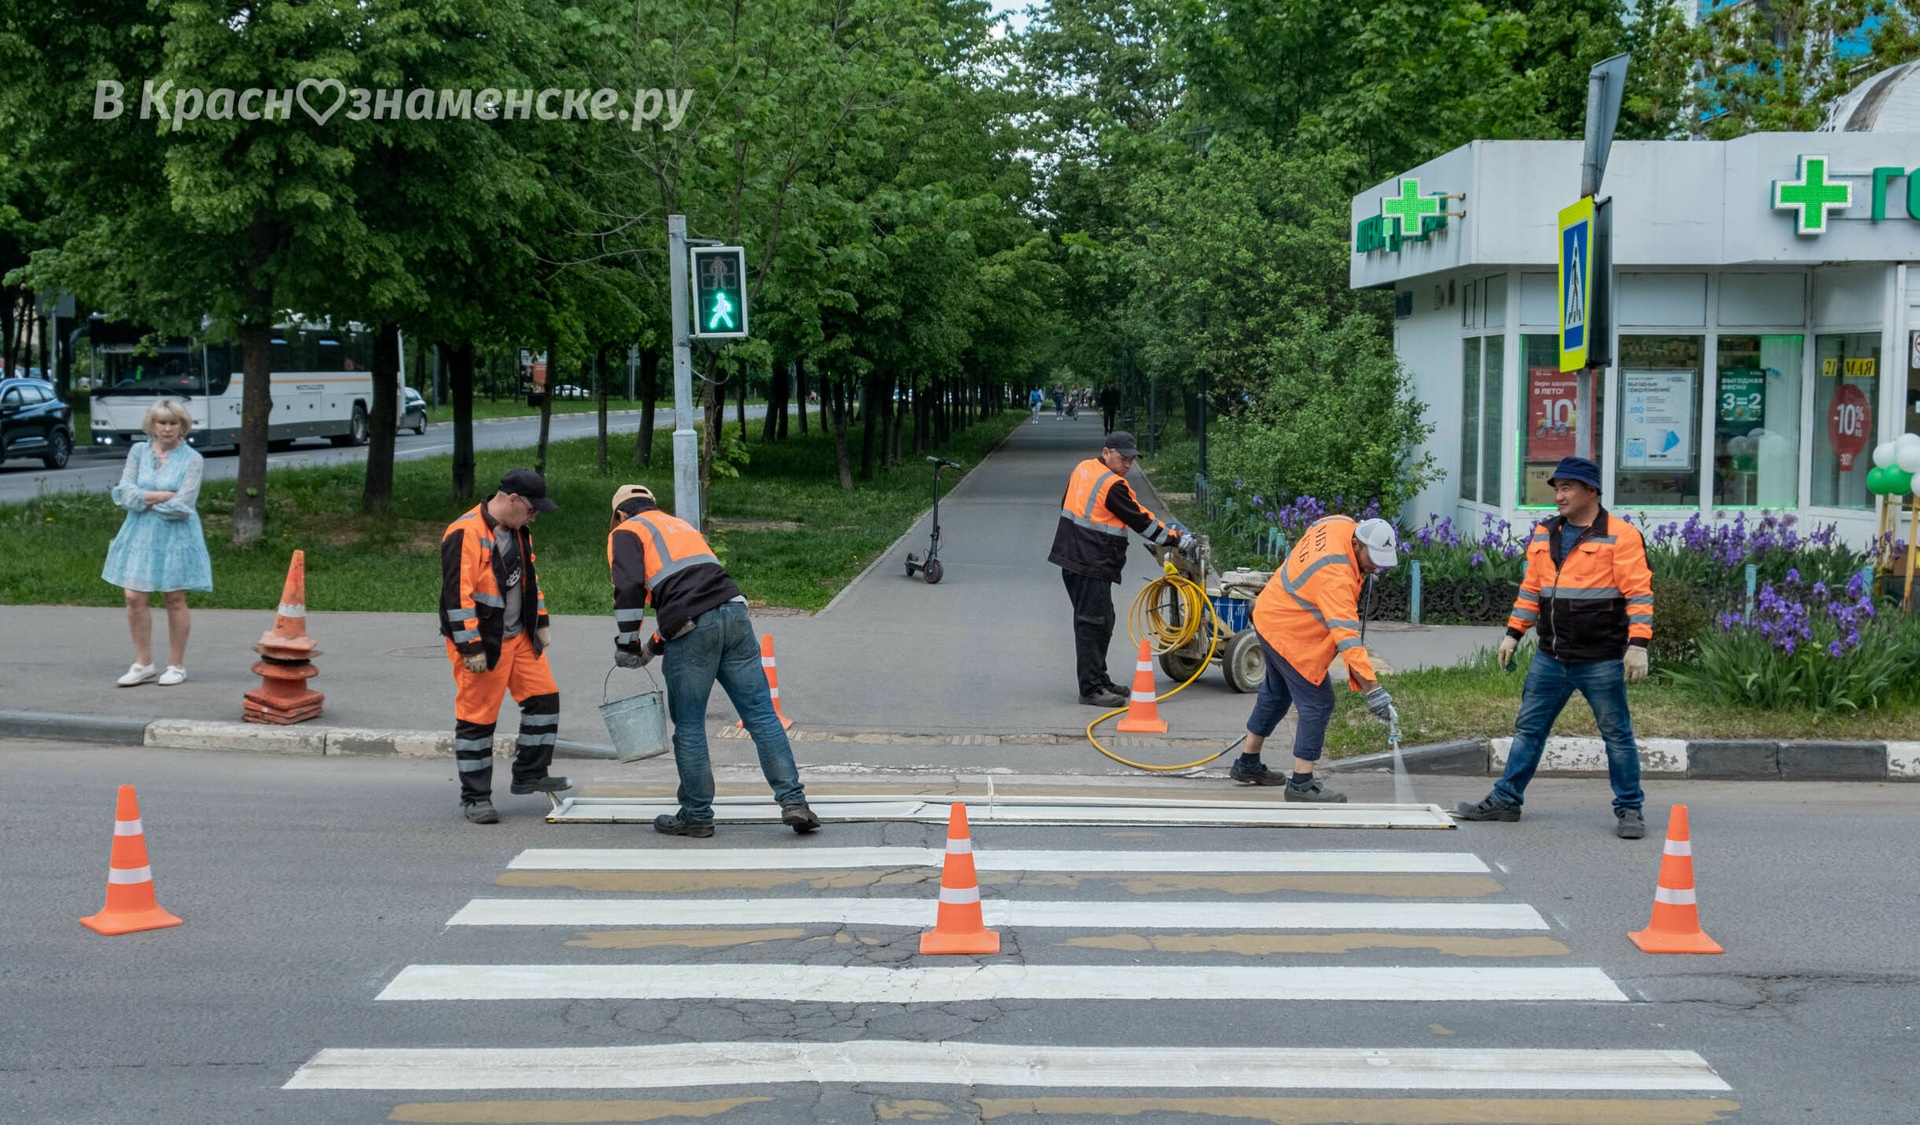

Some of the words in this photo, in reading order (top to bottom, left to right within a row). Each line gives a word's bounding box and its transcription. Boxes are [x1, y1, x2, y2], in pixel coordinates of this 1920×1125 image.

[1824, 360, 1837, 375] 21
[1845, 360, 1873, 376] МАЯ
[1535, 398, 1577, 428] -10
[1722, 393, 1761, 410] 3=2
[1833, 403, 1864, 436] -10%
